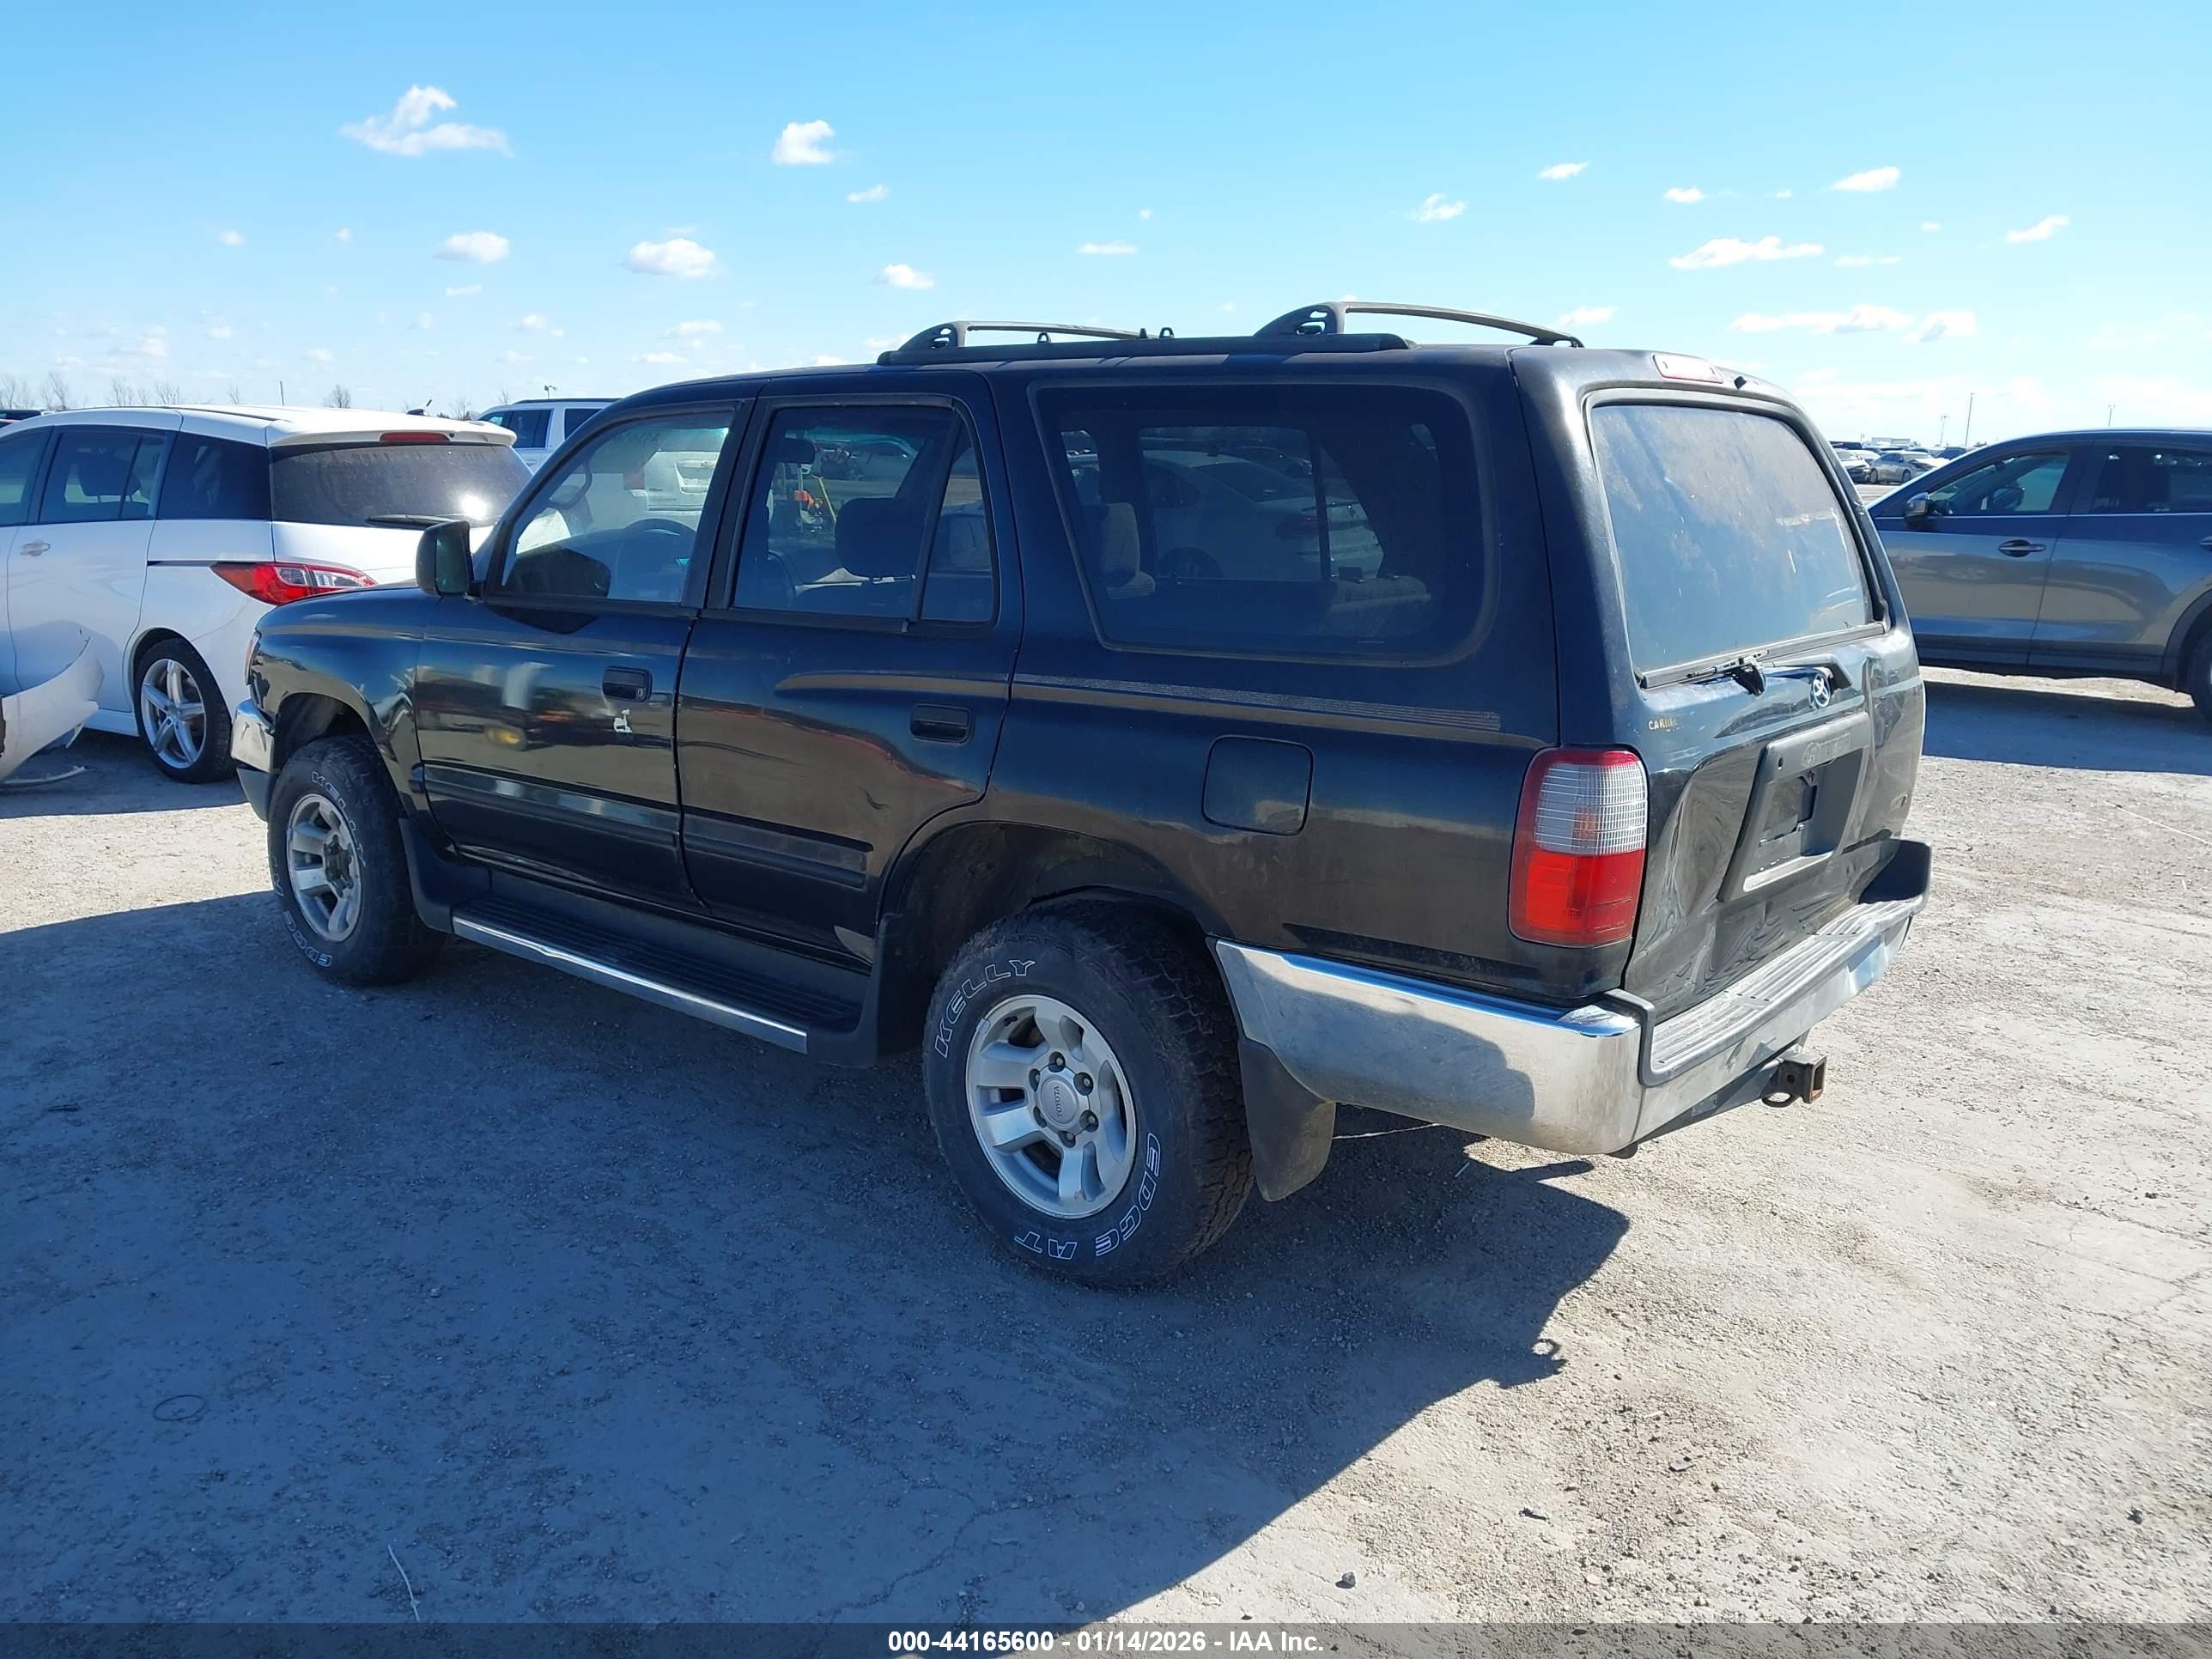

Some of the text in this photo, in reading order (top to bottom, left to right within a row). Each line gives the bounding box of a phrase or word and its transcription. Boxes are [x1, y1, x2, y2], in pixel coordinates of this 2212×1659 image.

[934, 959, 1036, 1059] KELLY
[1053, 1085, 1063, 1119] TOYOTA
[1013, 1133, 1161, 1260] EDGE AT
